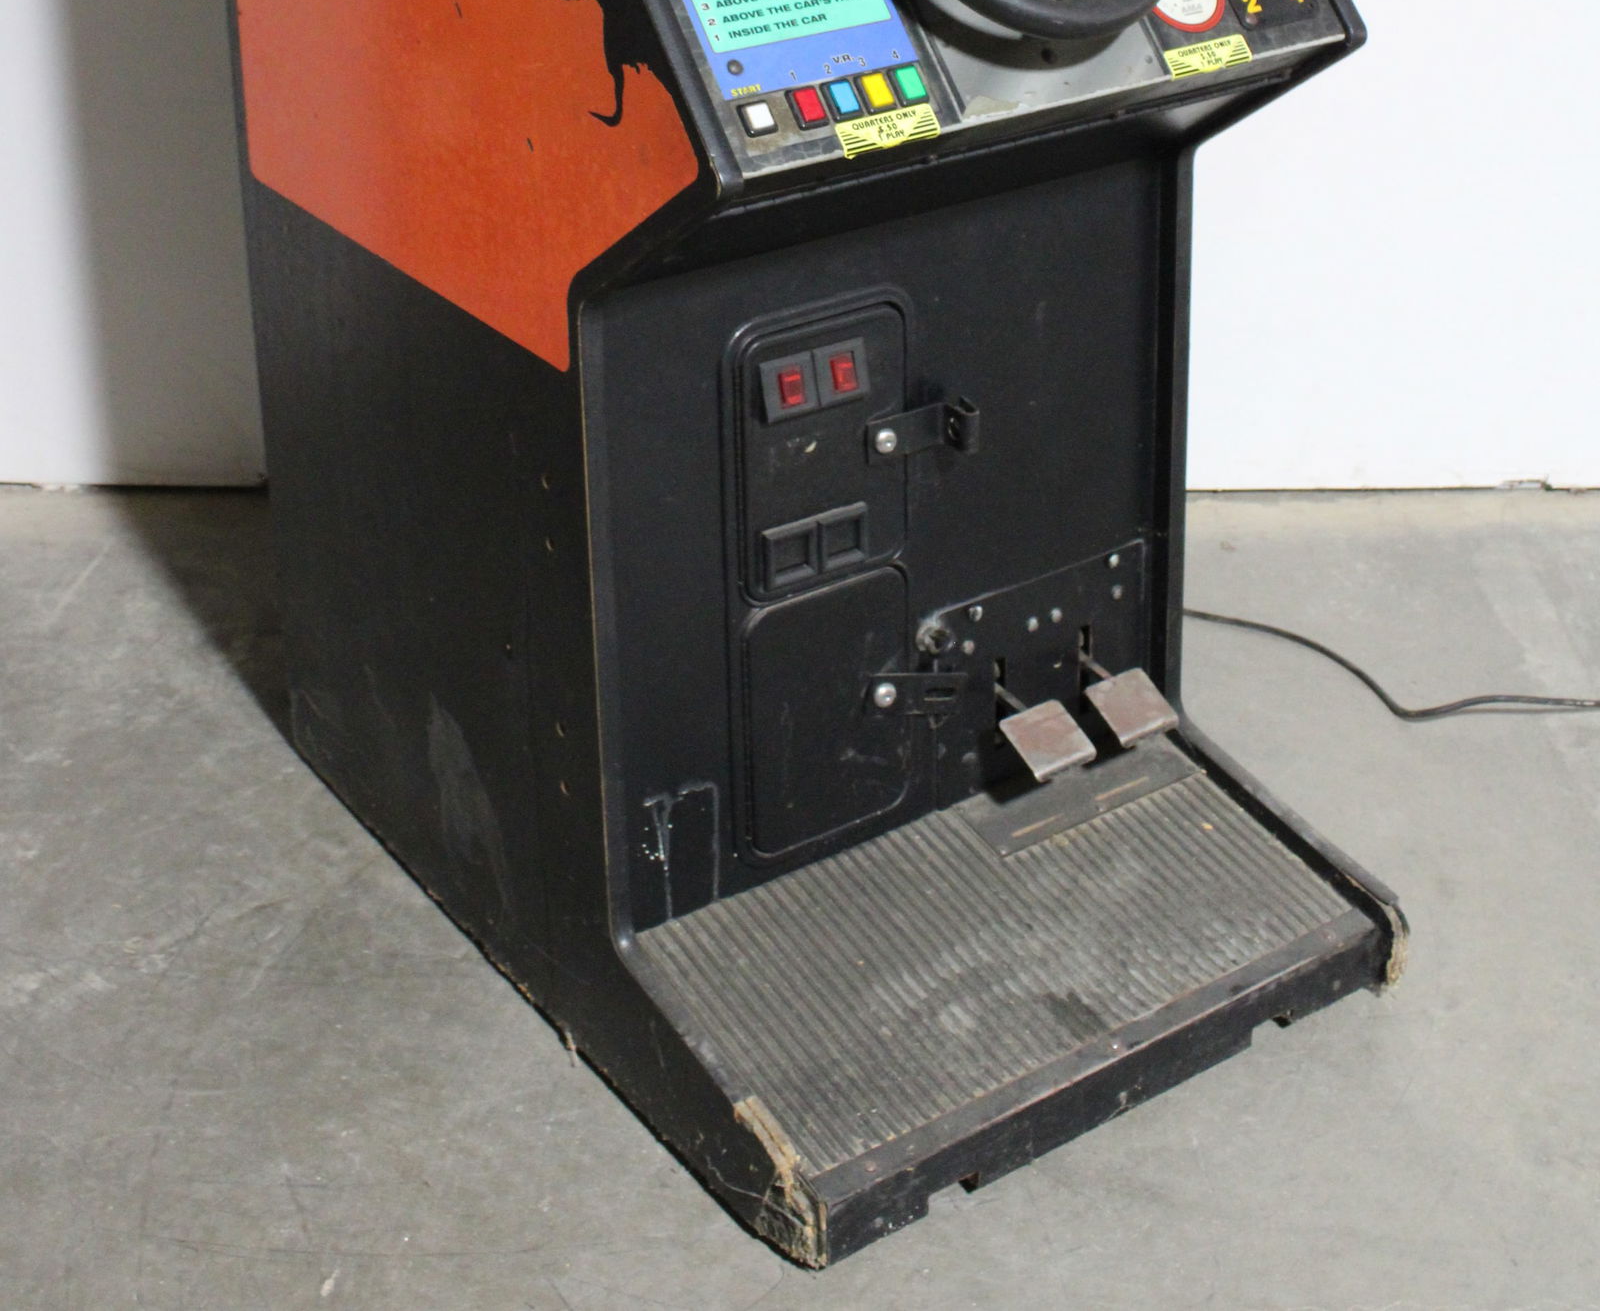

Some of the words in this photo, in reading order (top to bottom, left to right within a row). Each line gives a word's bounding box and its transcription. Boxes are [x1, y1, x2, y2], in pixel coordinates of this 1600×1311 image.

[701, 2, 710, 10] 3
[707, 18, 716, 26] 2
[722, 9, 764, 24] ABOVE
[766, 4, 792, 16] THE
[728, 24, 771, 39] INSIDE
[775, 19, 799, 31] THE
[802, 13, 828, 26] CAR
[789, 71, 797, 82] 1
[823, 63, 832, 74] 2
[858, 57, 866, 67] 3
[891, 50, 899, 59] 4
[832, 54, 855, 64] V.R.
[730, 83, 762, 98] START
[852, 114, 894, 131] QUARTERS
[897, 109, 916, 121] ONLY
[886, 129, 905, 140] PLAY
